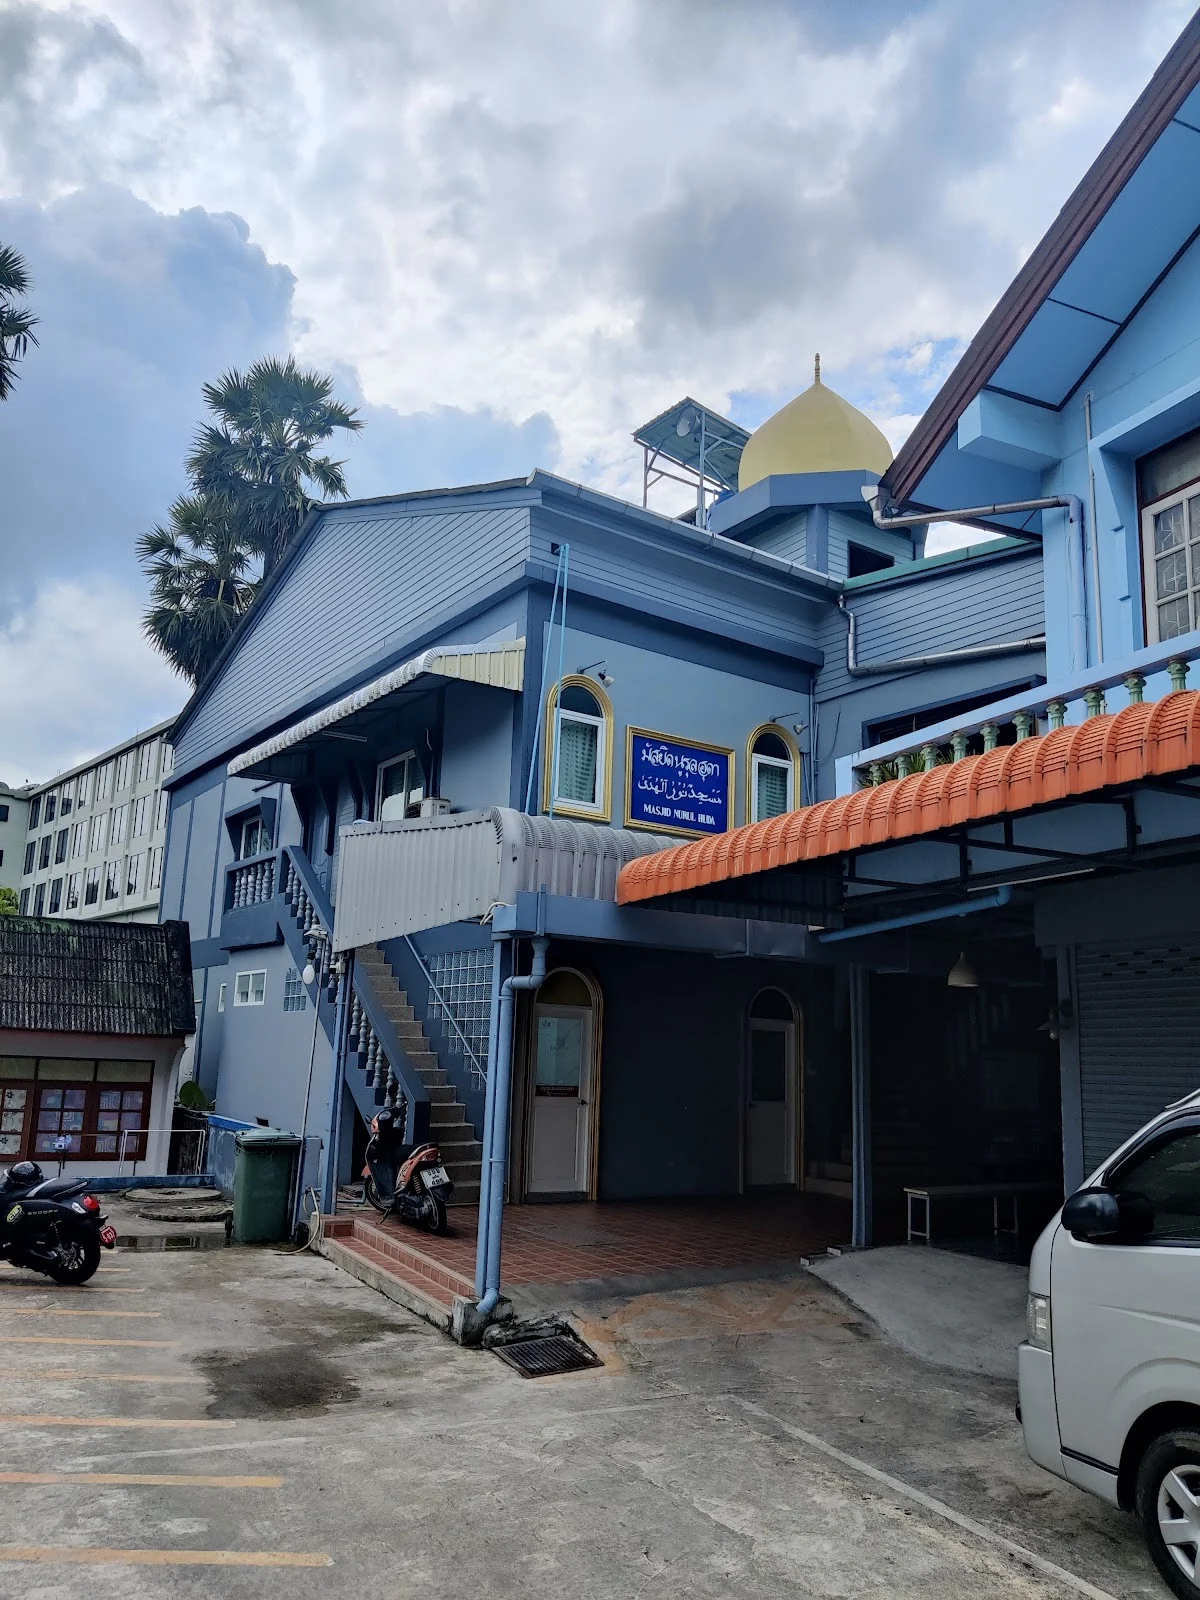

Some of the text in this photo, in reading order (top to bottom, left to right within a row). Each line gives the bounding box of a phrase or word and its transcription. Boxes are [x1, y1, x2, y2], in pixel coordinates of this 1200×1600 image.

[643, 803, 716, 825] MASJID NURUL HUDA
